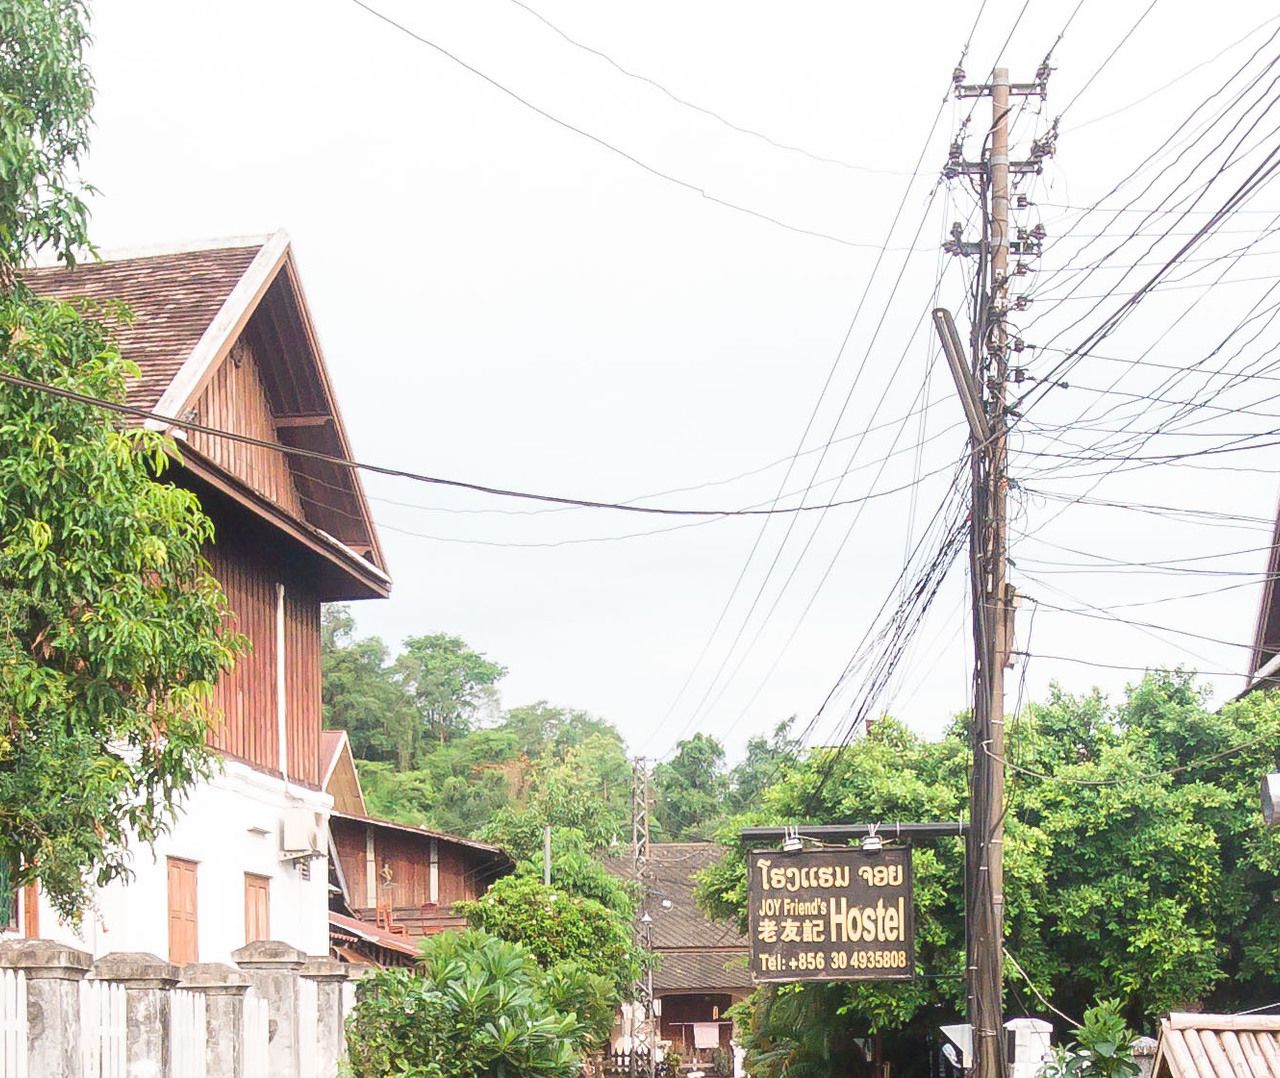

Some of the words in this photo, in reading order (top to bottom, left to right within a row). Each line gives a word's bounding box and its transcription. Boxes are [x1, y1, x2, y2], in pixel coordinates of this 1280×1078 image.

[757, 918, 826, 943] 老友記
[759, 899, 782, 917] JOY
[784, 897, 827, 916] Friend's
[830, 897, 905, 942] Hostel
[759, 954, 786, 971] Tel:
[789, 952, 825, 970] +856
[831, 952, 848, 969] 30
[850, 950, 907, 969] 4935808
